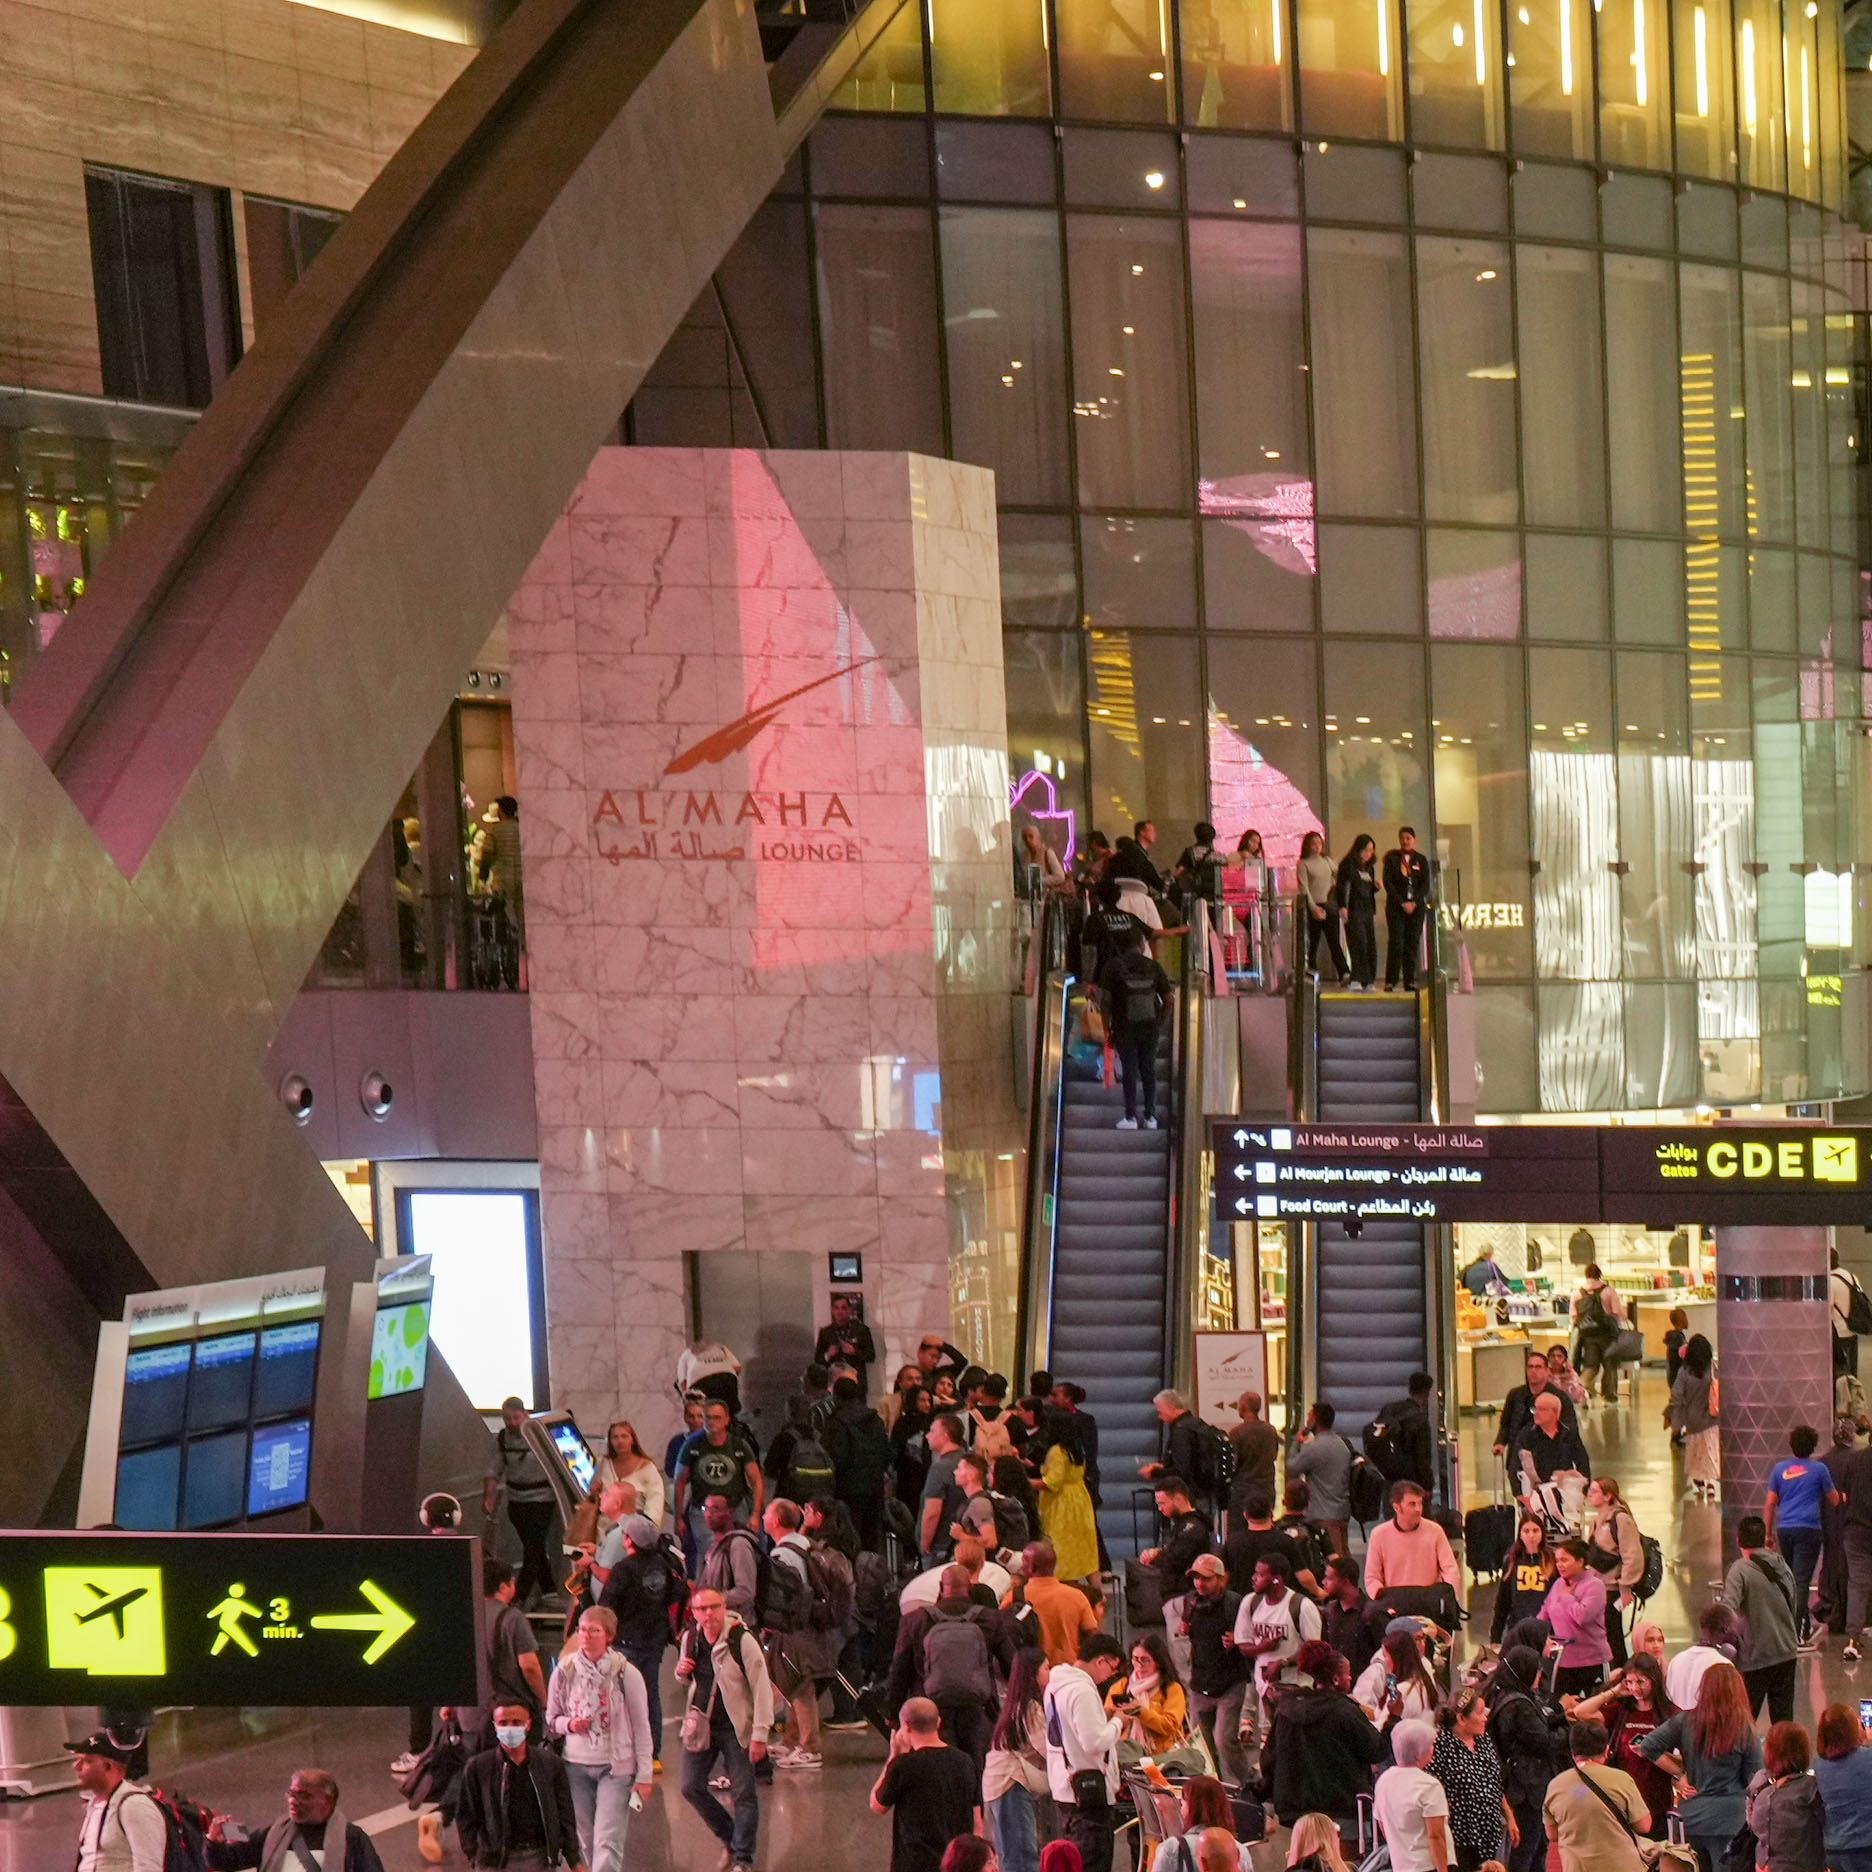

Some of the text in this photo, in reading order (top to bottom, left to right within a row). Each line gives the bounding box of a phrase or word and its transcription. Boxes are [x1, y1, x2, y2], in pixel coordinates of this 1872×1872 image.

[593, 790, 853, 827] AL MAHA
[670, 831, 746, 861] صالة
[761, 842, 860, 862] LOUNGE
[1296, 1134, 1309, 1145] Al
[1313, 1133, 1348, 1146] Maha
[1352, 1134, 1400, 1150] Lounge
[1414, 1134, 1484, 1152] صالة المها
[1656, 1143, 1698, 1162] بوابات
[1706, 1142, 1804, 1178] CDE
[1280, 1166, 1292, 1180] Al
[1296, 1166, 1344, 1184] Mourjan
[1346, 1167, 1390, 1184] Lounge
[1401, 1167, 1482, 1185] صالة المرجان
[1660, 1164, 1698, 1178] Gates
[1280, 1199, 1310, 1213] Food
[1312, 1200, 1348, 1214] Court
[1358, 1200, 1436, 1217] ركن المطاعم
[269, 1598, 290, 1622] 3
[262, 1623, 304, 1640] min.
